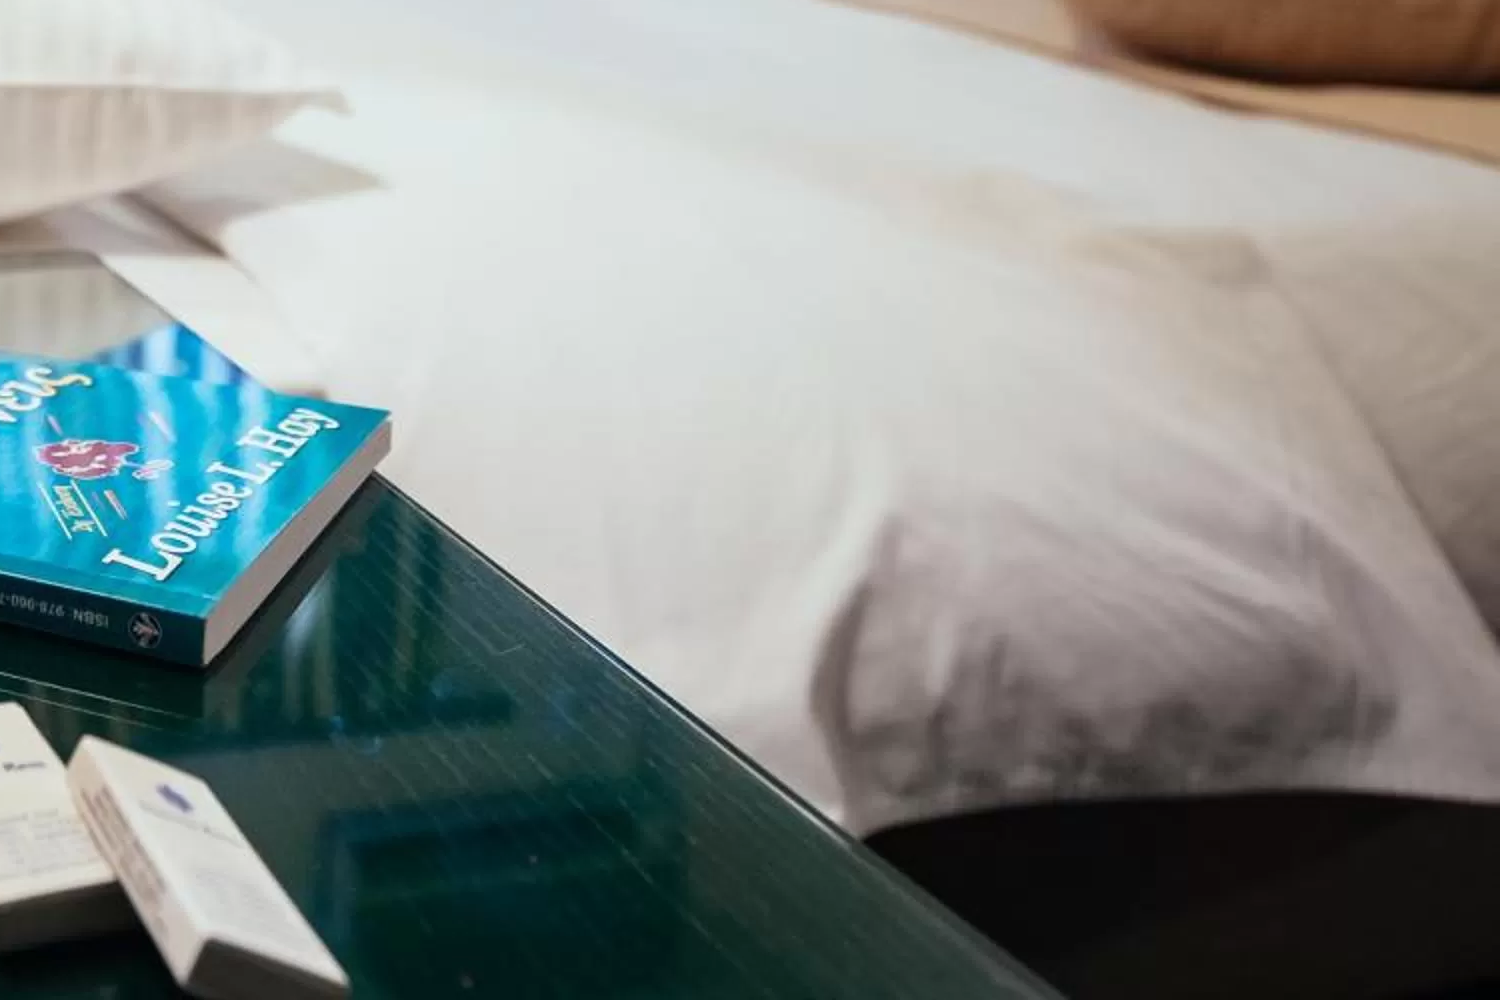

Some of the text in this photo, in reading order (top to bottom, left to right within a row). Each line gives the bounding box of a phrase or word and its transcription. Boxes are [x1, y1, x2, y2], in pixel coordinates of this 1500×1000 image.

[102, 406, 341, 582] Louise L. Hay
[72, 607, 110, 630] ISBN
